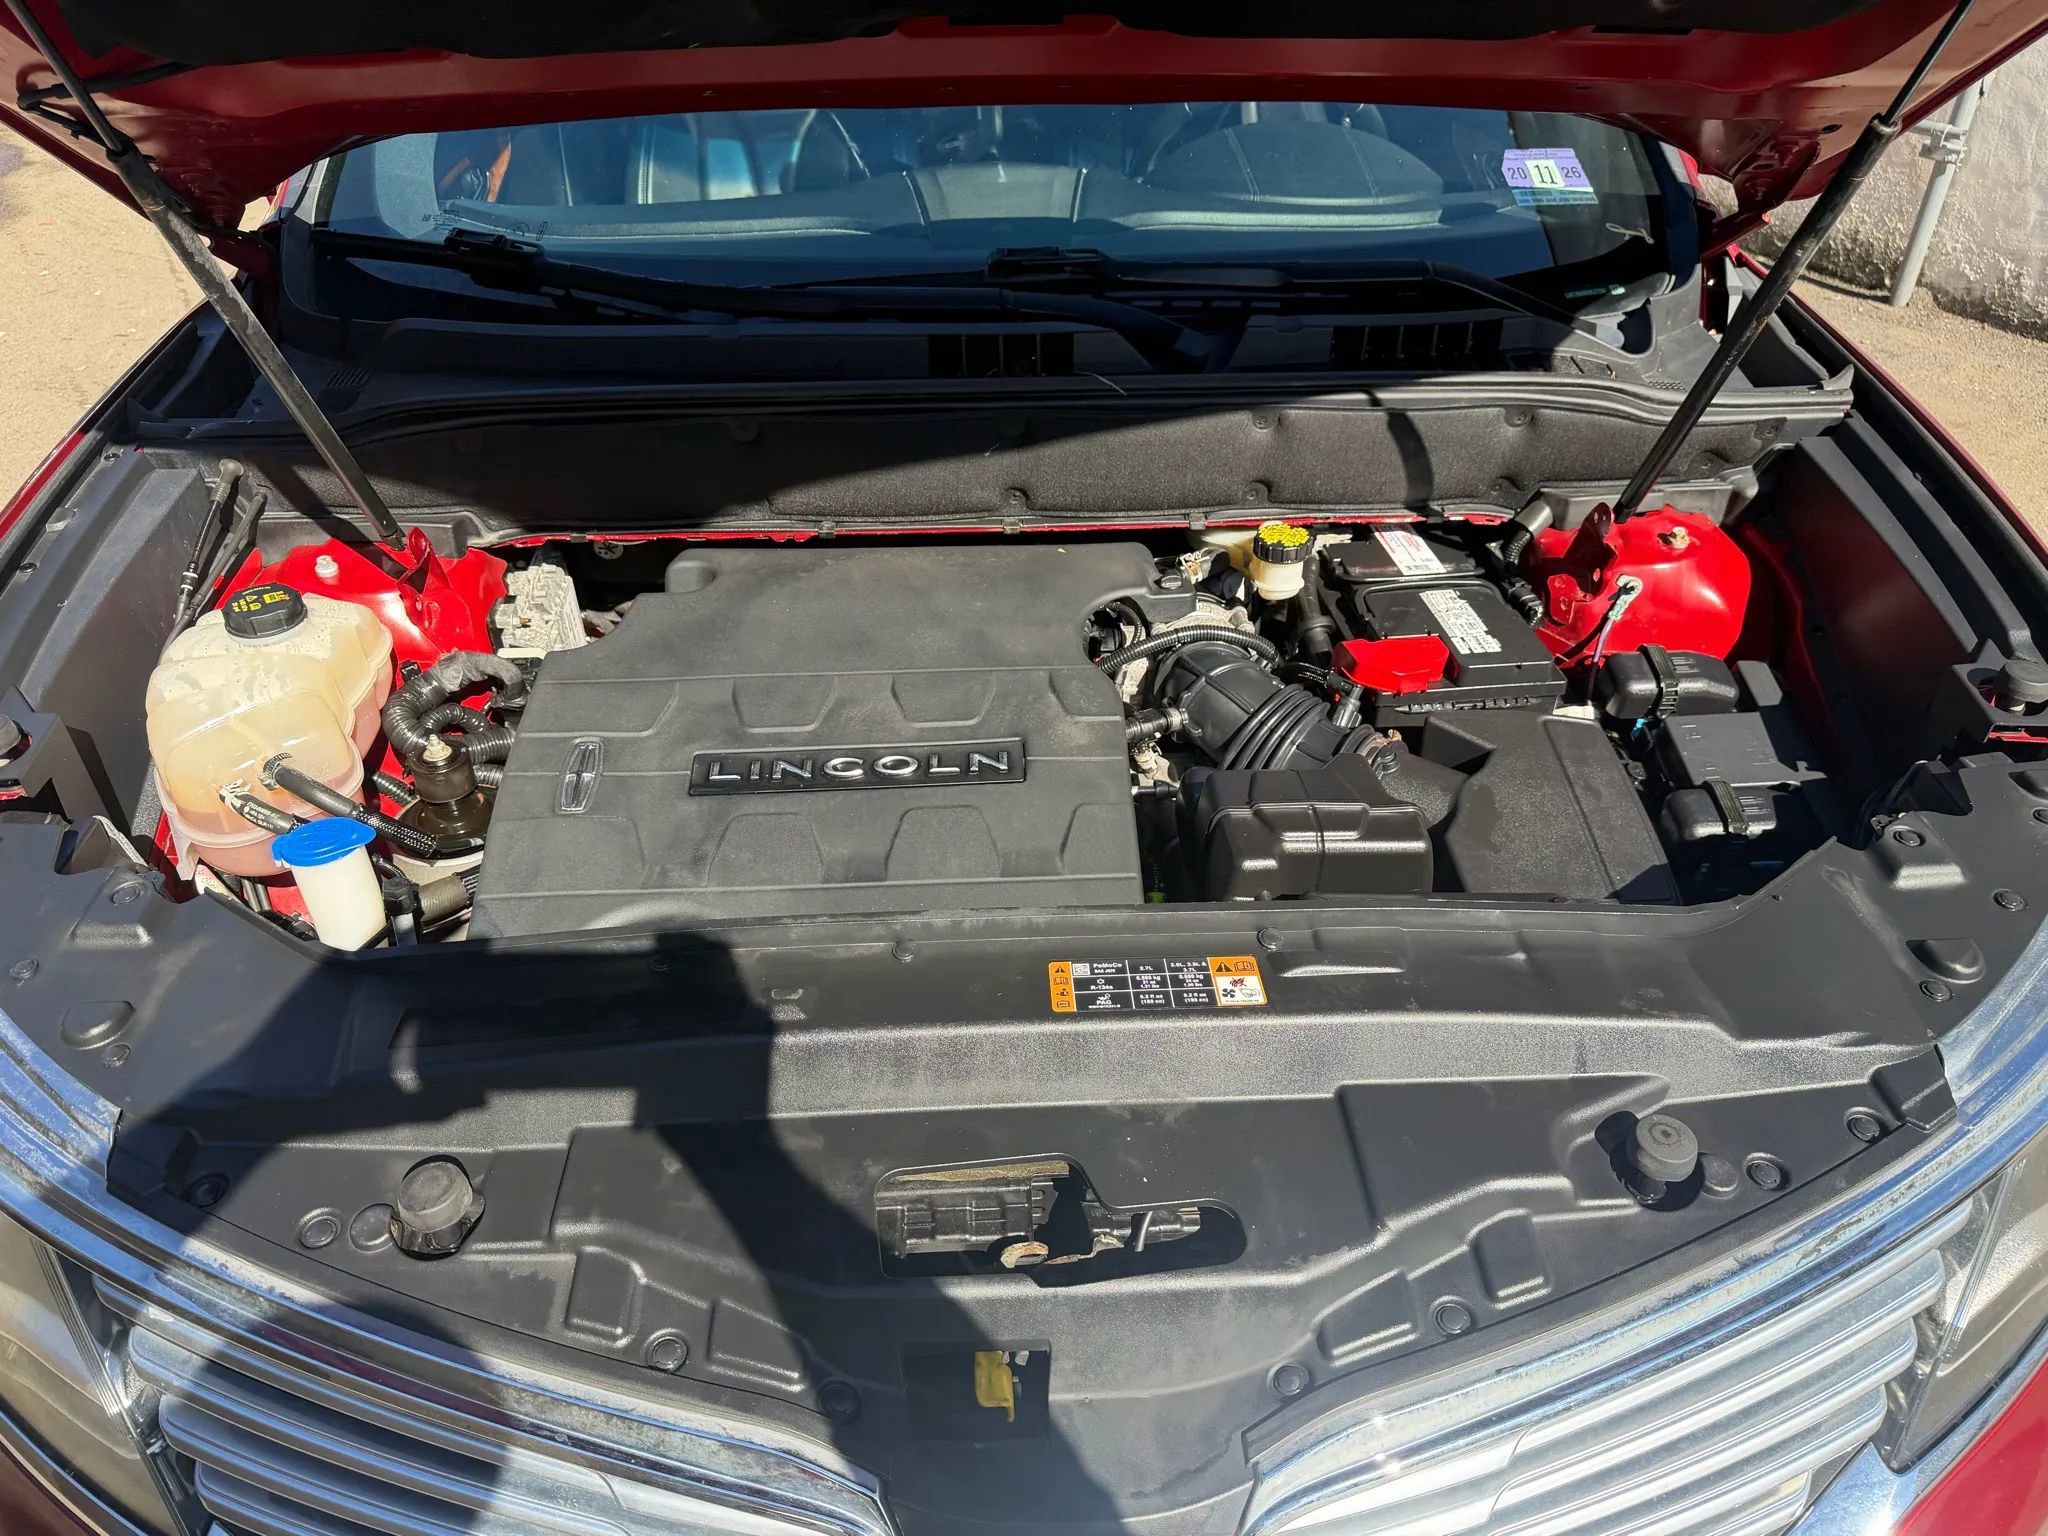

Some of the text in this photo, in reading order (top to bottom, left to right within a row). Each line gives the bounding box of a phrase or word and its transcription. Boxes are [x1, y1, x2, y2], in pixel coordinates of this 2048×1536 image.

[1507, 164, 1582, 185] 20 11 26
[708, 751, 1009, 781] LINCOLN
